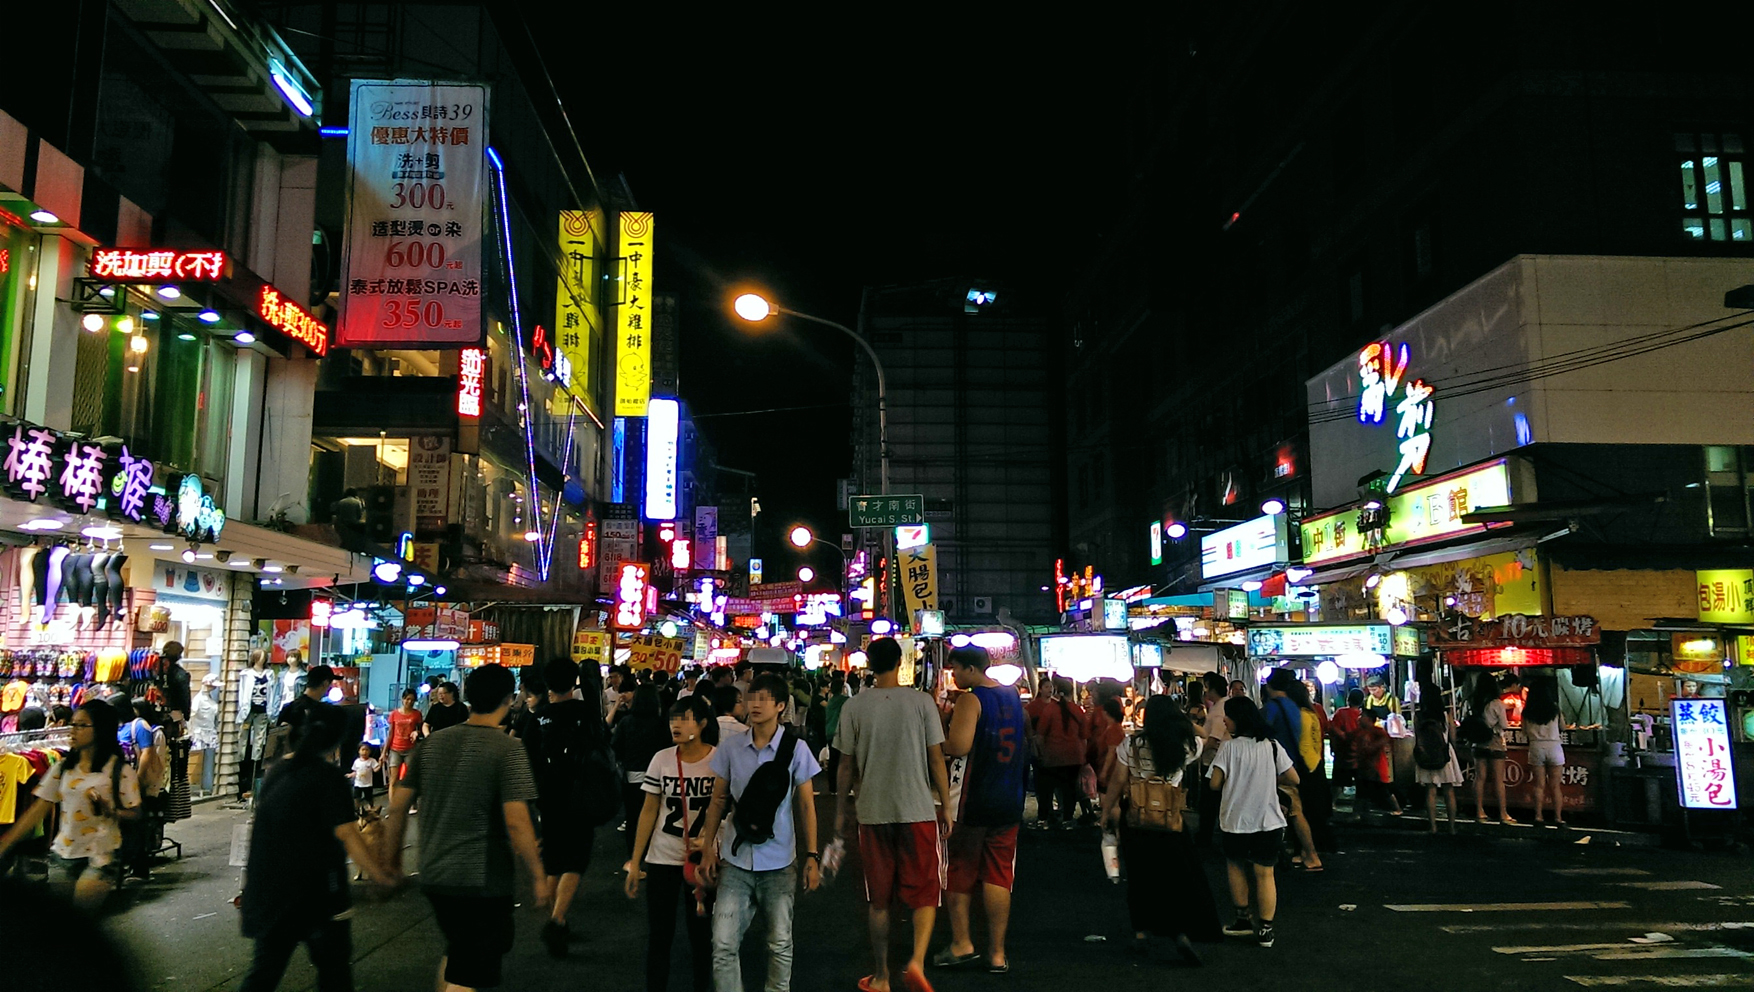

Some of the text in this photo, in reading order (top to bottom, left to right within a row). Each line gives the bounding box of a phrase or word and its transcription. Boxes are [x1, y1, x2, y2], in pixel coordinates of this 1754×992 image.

[371, 126, 469, 145] 優惠大特價
[398, 152, 440, 170] 洗+剪
[857, 500, 916, 512] 育才南街
[859, 514, 915, 524] Yucai S. St.
[652, 650, 681, 674] 50
[1678, 702, 1725, 726] 蒸餃
[1698, 738, 1733, 806] 小湯包
[661, 796, 712, 838] 27
